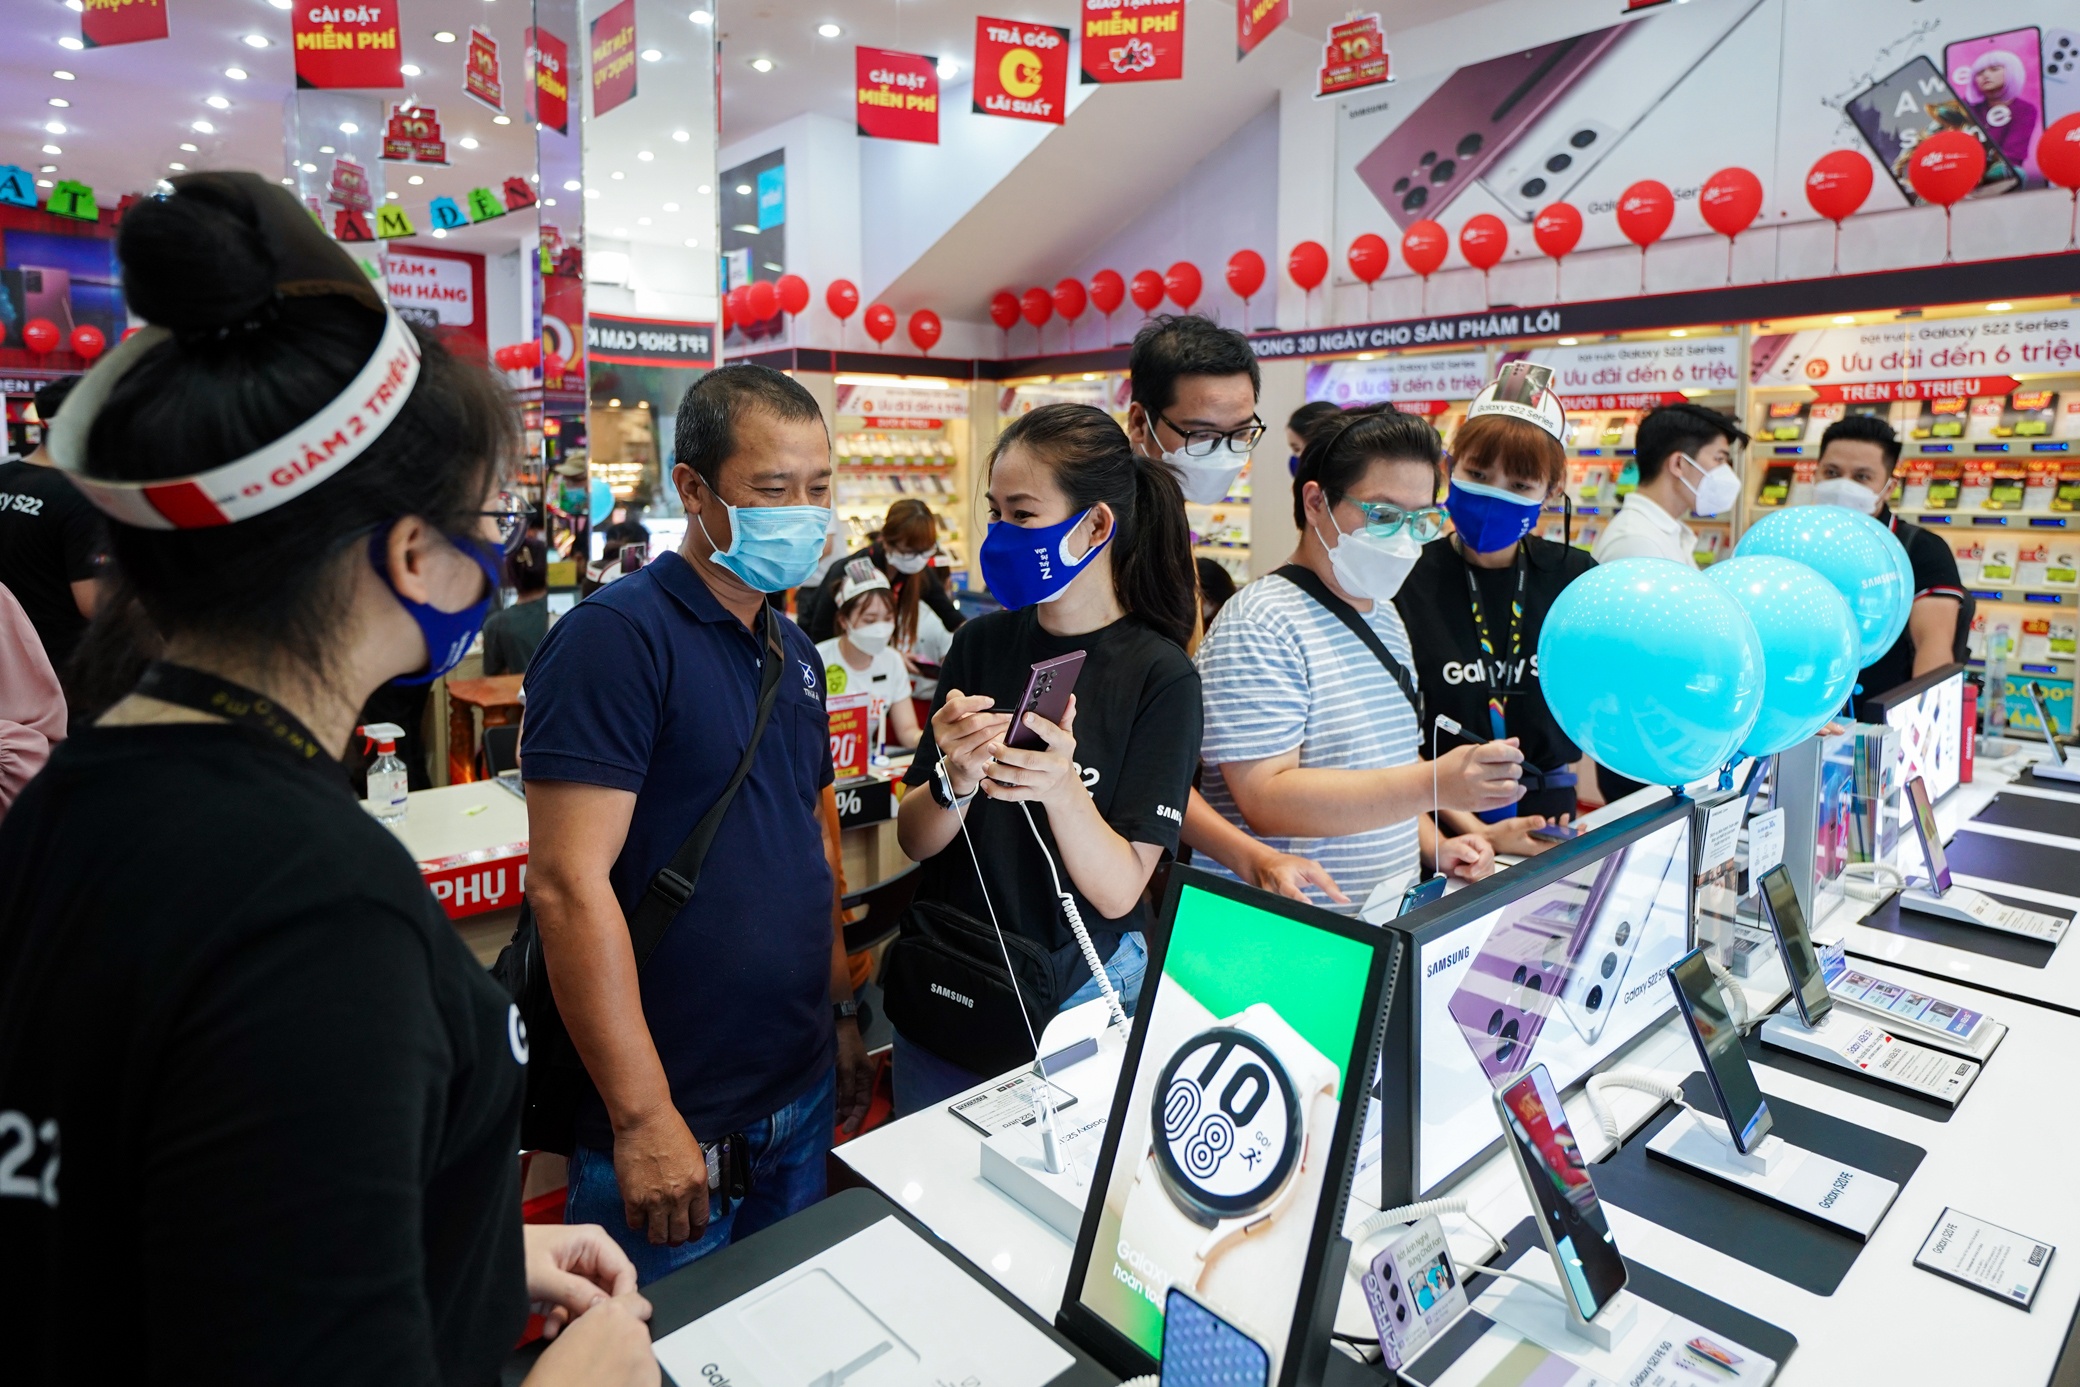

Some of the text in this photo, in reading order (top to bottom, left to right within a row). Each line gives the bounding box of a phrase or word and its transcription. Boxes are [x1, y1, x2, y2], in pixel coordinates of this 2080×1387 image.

[309, 7, 381, 26] CÀI ĐẶT
[1086, 10, 1180, 37] MIỄN PHÍ
[296, 24, 396, 50] MIỄN PHÍ
[986, 26, 1061, 49] TRẢ GÓP
[1340, 37, 1370, 62] 10
[870, 69, 927, 90] CÀI ĐẶT
[858, 84, 937, 113] MIỄN PHÍ
[986, 95, 1053, 116] LÃI SUẤT
[402, 120, 429, 138] 10
[1297, 335, 1318, 353] 30
[1319, 329, 1367, 351] NGÀY
[1370, 328, 1411, 347] CHO
[1414, 320, 1455, 343] SẢN
[1918, 326, 1976, 341] Galaxy
[1982, 322, 2010, 337] S22
[2014, 317, 2070, 333] Series
[1687, 344, 1726, 356] Series
[1841, 352, 1872, 371] Ưu
[1930, 342, 1986, 367] đến
[1995, 344, 2011, 363] 6
[1437, 377, 1446, 392] 6
[1564, 367, 1587, 387] Ưu
[1626, 361, 1666, 384] đến
[1672, 366, 1685, 384] 6
[1601, 395, 1616, 409] 10
[1840, 379, 1981, 400] TRÊN 10 TRIỆU
[1477, 402, 1555, 429] Galaxy S22 Series
[269, 430, 349, 487] GIẢM
[347, 415, 367, 437] 2
[11, 493, 44, 516] S22
[1442, 657, 1526, 685] Galxy
[429, 867, 506, 907] PHỤ
[1426, 945, 1470, 978] SAMSUNG
[930, 982, 975, 1009] SAMSUNG
[1623, 981, 1648, 1005] Galaxy
[1647, 972, 1659, 989] S22
[1076, 1117, 1108, 1134] Galaxy
[1255, 1130, 1272, 1148] GO!
[1818, 1171, 1854, 1209] Galaxy S20 FE
[1932, 1236, 1953, 1254] Galaxy
[1116, 1240, 1175, 1287] Galaxy
[1112, 1261, 1143, 1294] hoàn
[1654, 1348, 1667, 1359] FE
[1659, 1341, 1672, 1351] 5G
